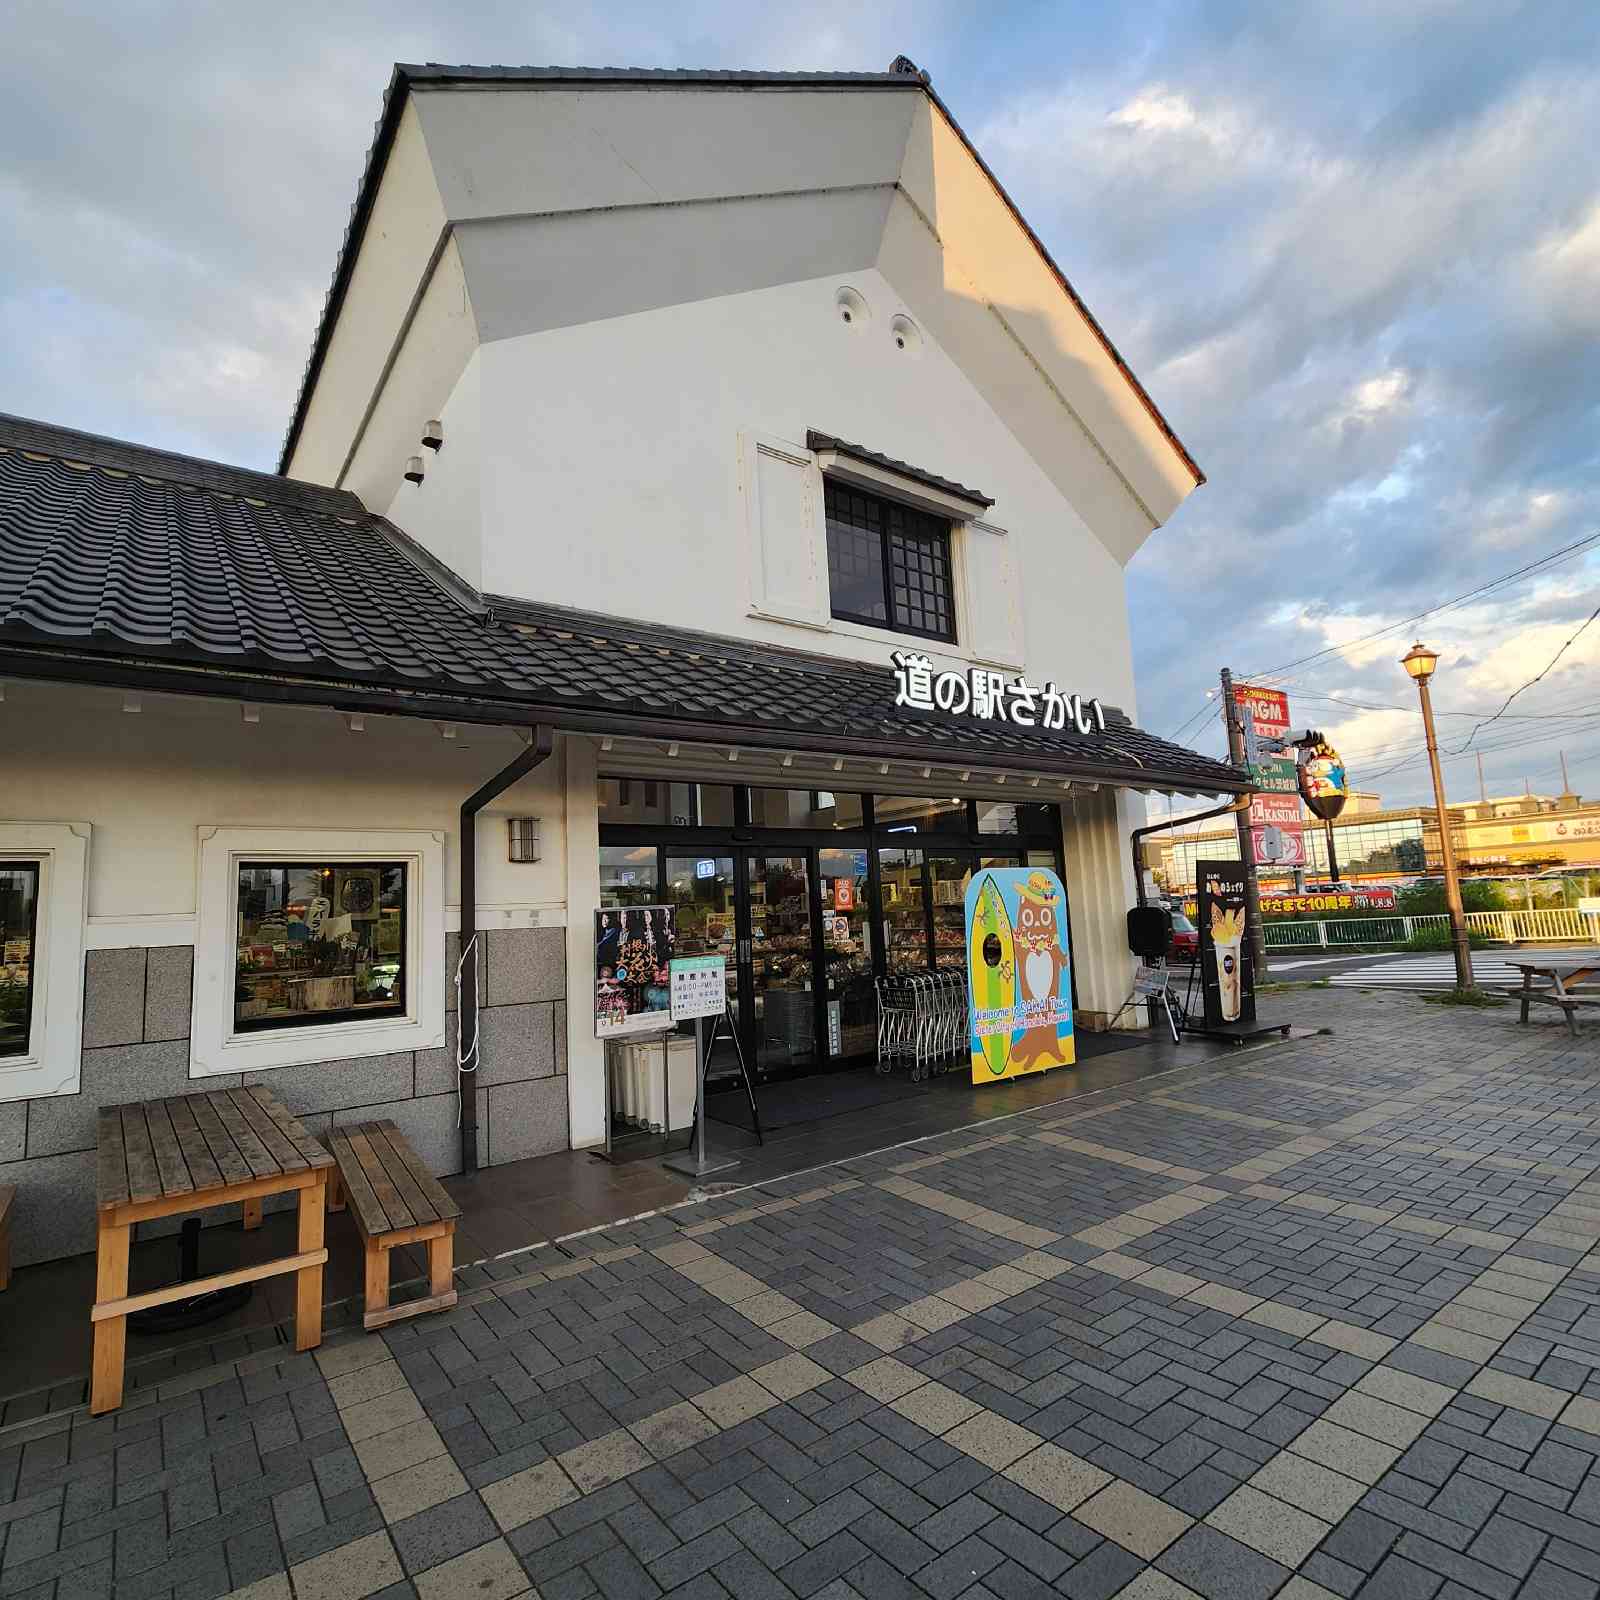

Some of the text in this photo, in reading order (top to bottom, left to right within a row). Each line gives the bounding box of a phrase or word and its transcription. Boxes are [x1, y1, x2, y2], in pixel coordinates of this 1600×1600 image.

[891, 651, 1105, 734] 道の駅さかい
[1264, 808, 1301, 822] KASUMI
[973, 1007, 1009, 1021] Welcome
[1020, 998, 1048, 1014] SAKAI
